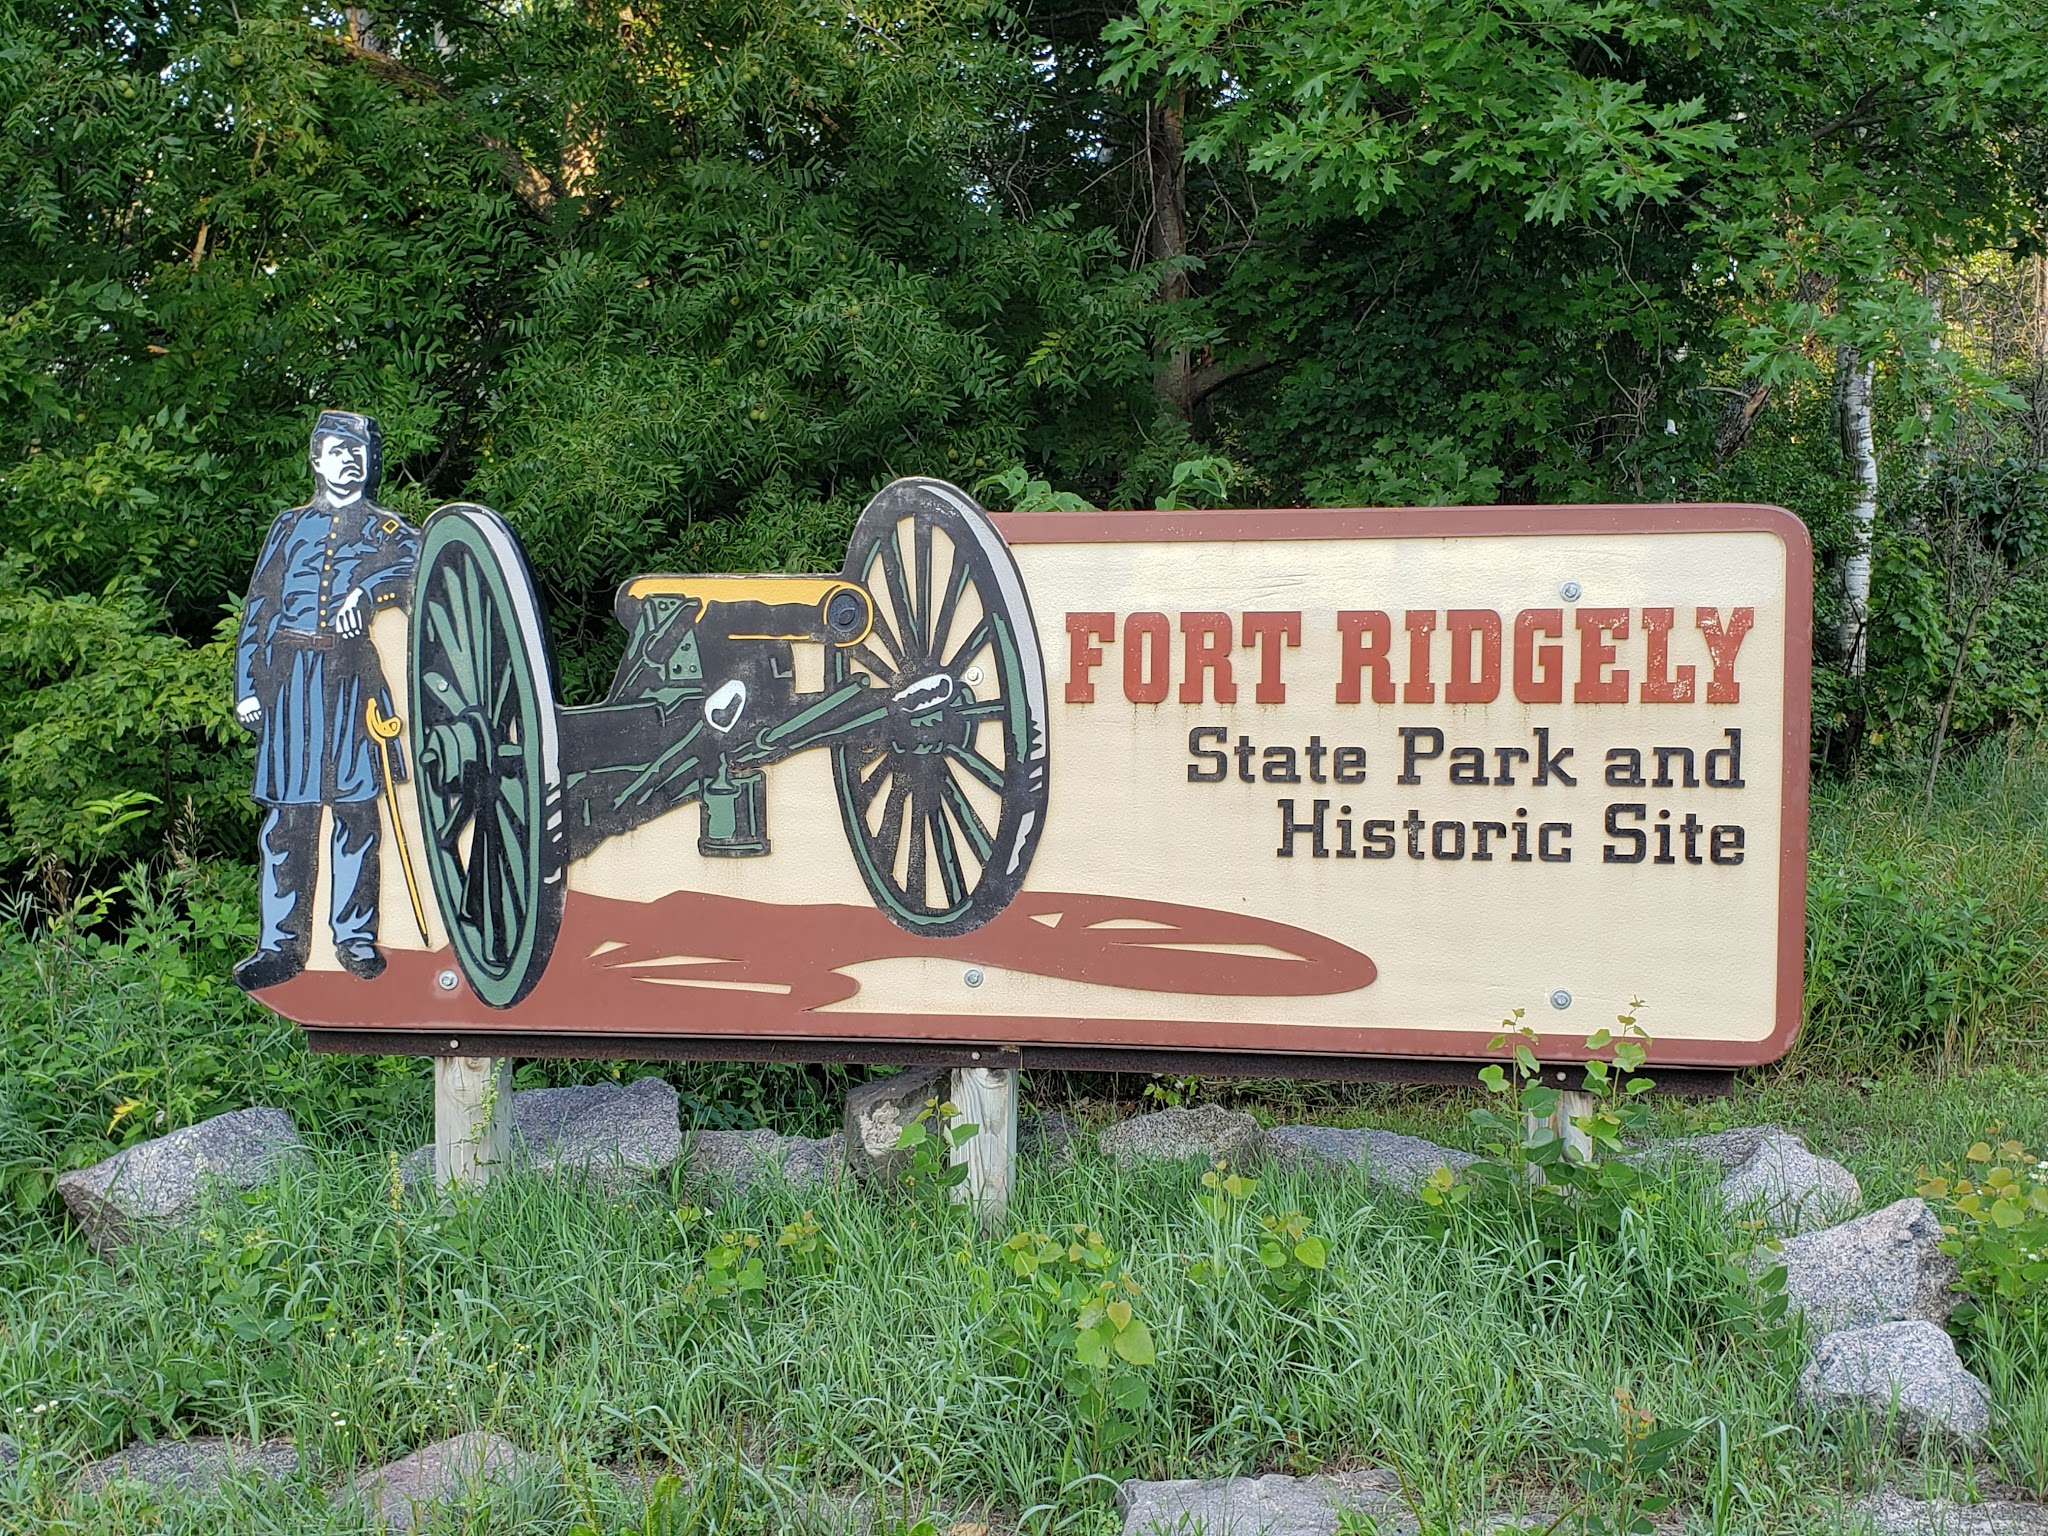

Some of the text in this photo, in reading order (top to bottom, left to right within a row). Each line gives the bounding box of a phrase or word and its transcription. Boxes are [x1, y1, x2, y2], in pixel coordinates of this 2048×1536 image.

[1065, 607, 1754, 704] FORT RIDGELY
[1188, 726, 1745, 789] State Park and
[1277, 798, 1745, 865] Historic Site
